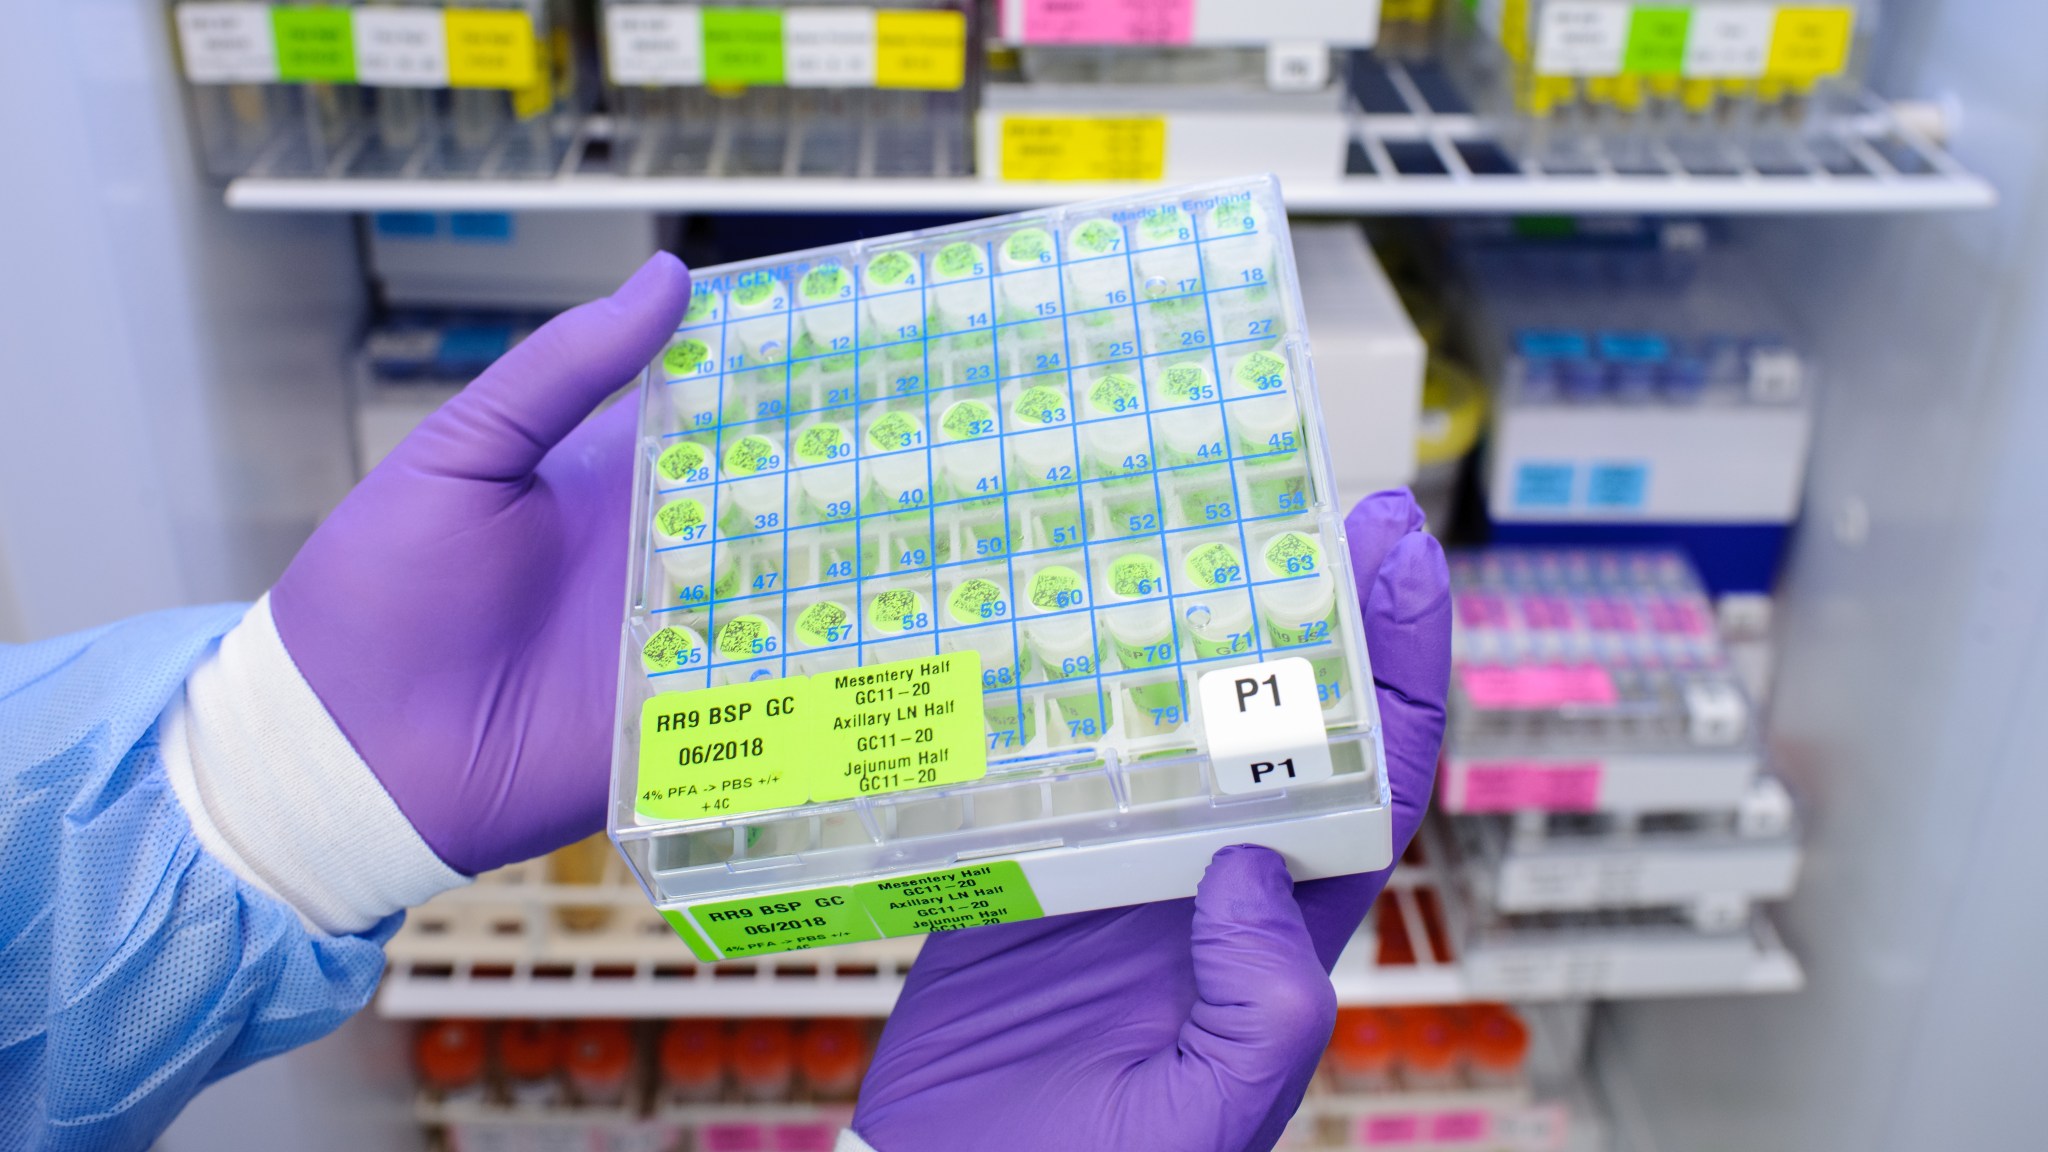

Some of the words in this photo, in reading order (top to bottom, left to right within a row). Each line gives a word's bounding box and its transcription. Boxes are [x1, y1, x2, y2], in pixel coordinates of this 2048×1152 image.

[1111, 207, 1157, 224] Made
[1243, 217, 1254, 229] 9
[1178, 228, 1190, 239] 8
[1110, 240, 1120, 250] 7
[1040, 251, 1051, 262] 6
[973, 264, 983, 275] 5
[1241, 269, 1264, 282] 18
[905, 274, 915, 285] 4
[1177, 279, 1198, 292] 17
[841, 286, 851, 296] 3
[1106, 291, 1126, 303] 16
[773, 298, 784, 309] 2
[1036, 303, 1056, 314] 15
[711, 310, 718, 320] 1
[968, 314, 987, 326] 14
[899, 326, 917, 338] 13
[1248, 320, 1272, 334] 27
[830, 338, 849, 350] 12
[1181, 331, 1205, 344] 26
[1110, 342, 1133, 356] 25
[694, 361, 714, 373] 10
[728, 355, 743, 368] 11
[1036, 354, 1060, 368] 24
[966, 366, 990, 378] 23
[896, 377, 919, 390] 22
[1257, 374, 1282, 390] 36
[828, 389, 849, 402] 21
[1189, 386, 1213, 401] 35
[758, 401, 782, 415] 20
[1114, 397, 1138, 412] 34
[693, 412, 712, 426] 19
[1042, 408, 1066, 423] 33
[969, 420, 994, 435] 32
[900, 431, 922, 446] 31
[1268, 432, 1294, 447] 45
[827, 444, 850, 458] 30
[1198, 443, 1222, 458] 44
[756, 456, 779, 470] 29
[1122, 454, 1148, 469] 43
[686, 468, 709, 482] 28
[1046, 466, 1071, 481] 42
[976, 476, 1000, 492] 41
[899, 489, 923, 504] 40
[1279, 492, 1304, 508] 54
[827, 502, 851, 516] 39
[1206, 504, 1231, 520] 53
[754, 513, 778, 528] 38
[1130, 515, 1155, 530] 52
[682, 526, 707, 540] 37
[1053, 528, 1077, 543] 51
[976, 538, 1002, 554] 50
[900, 550, 925, 566] 49
[1288, 556, 1314, 572] 63
[827, 562, 852, 577] 48
[1214, 567, 1240, 584] 62
[753, 574, 778, 589] 47
[1139, 578, 1163, 594] 61
[680, 586, 704, 600] 46
[1056, 590, 1082, 606] 60
[980, 602, 1006, 618] 59
[902, 614, 928, 630] 58
[1300, 621, 1328, 638] 72
[827, 626, 853, 642] 57
[1228, 633, 1252, 650] 71
[751, 637, 776, 653] 56
[1144, 644, 1171, 661] 70
[676, 649, 701, 666] 55
[1062, 656, 1089, 673] 69
[835, 669, 914, 689] Mesentery
[920, 660, 950, 676] Half
[984, 668, 1010, 685] 68
[1235, 674, 1281, 712] P1
[657, 710, 700, 732] RR9
[709, 703, 752, 725] BSP
[766, 696, 794, 717] GC
[834, 712, 891, 730] Axillary
[898, 705, 917, 720] LN
[925, 700, 954, 716] Half
[1151, 707, 1178, 725] 79
[1068, 719, 1094, 736] 78
[988, 732, 1014, 749] 77
[679, 737, 763, 766] 06/2018
[844, 757, 910, 779] Jejunum
[919, 748, 948, 764] Half
[1250, 758, 1296, 783] P1
[643, 791, 662, 800] 4%
[668, 785, 698, 798] PFA
[722, 777, 752, 791] PBS
[878, 873, 955, 890] Mesentery
[961, 867, 991, 878] Half
[889, 896, 943, 909] Axillary
[949, 891, 969, 900] LN
[974, 886, 1003, 897] Half
[709, 909, 753, 922] RR9
[759, 901, 802, 915] BSP
[814, 896, 845, 908] GC
[745, 916, 826, 935] 06/2018
[912, 913, 973, 929] Jejunum
[979, 908, 1007, 919] Half
[748, 941, 777, 949] PFA
[797, 934, 826, 943] PBS
